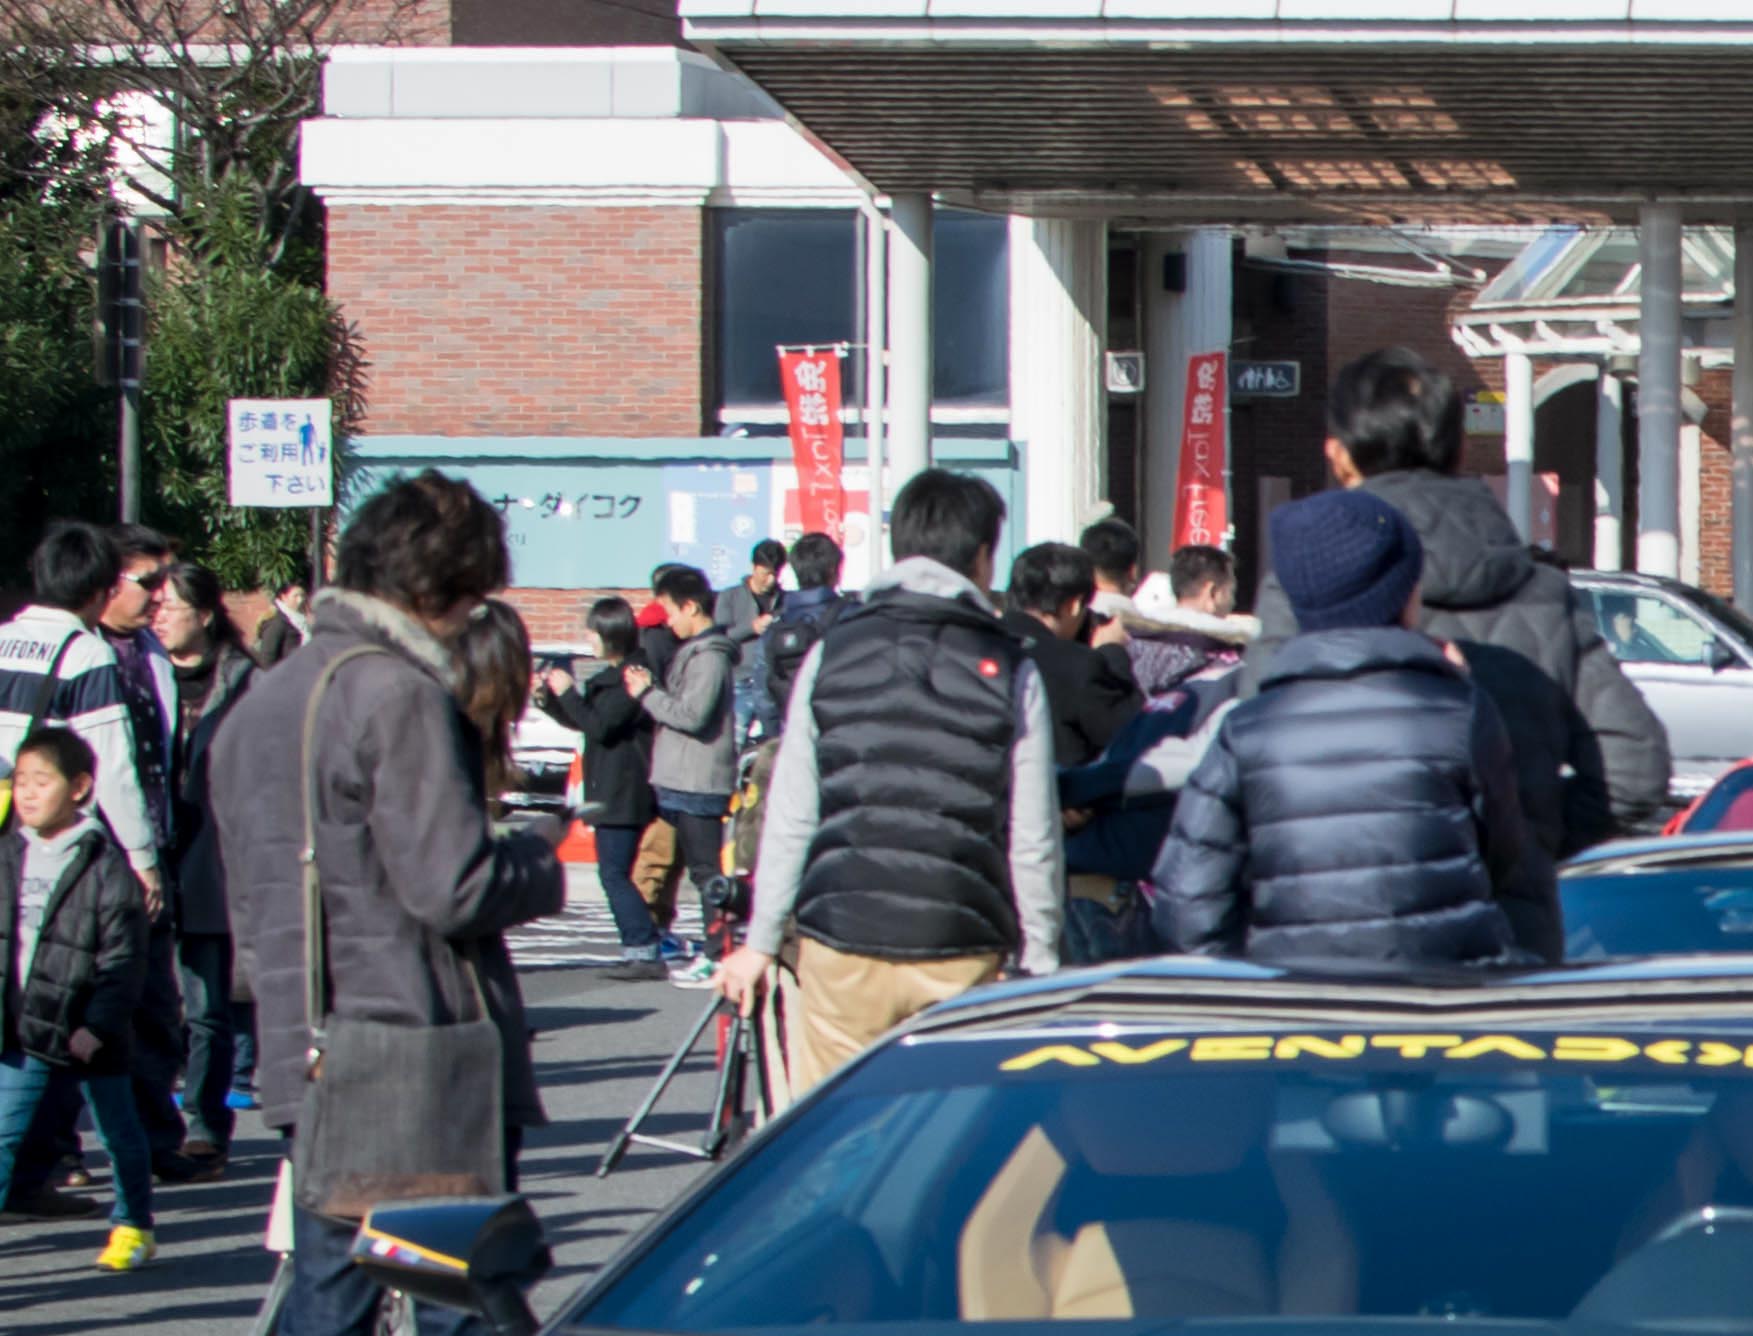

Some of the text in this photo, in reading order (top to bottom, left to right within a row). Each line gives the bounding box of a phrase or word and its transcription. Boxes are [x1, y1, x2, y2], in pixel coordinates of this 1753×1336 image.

[239, 411, 298, 432] 歩道を
[239, 443, 299, 463] ご利用
[265, 473, 326, 494] 下さい
[1184, 430, 1212, 547] Tax Free
